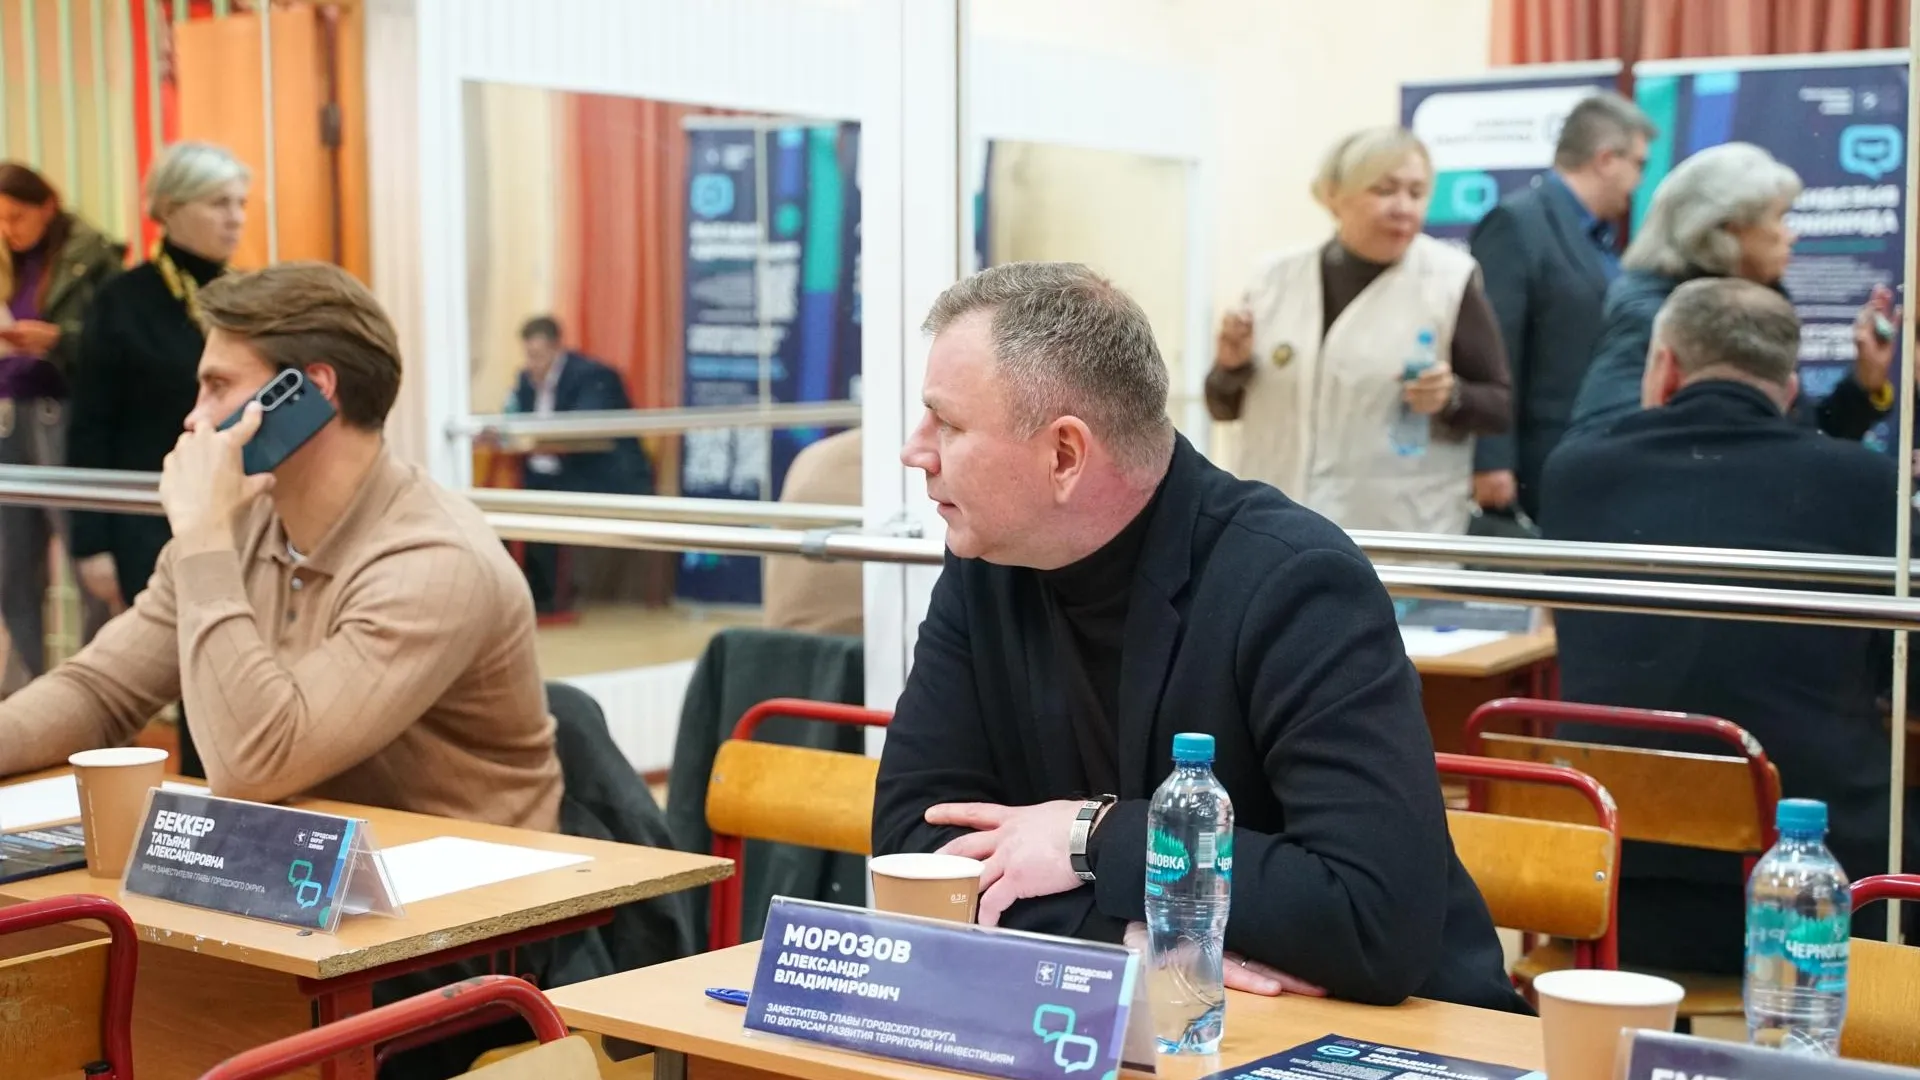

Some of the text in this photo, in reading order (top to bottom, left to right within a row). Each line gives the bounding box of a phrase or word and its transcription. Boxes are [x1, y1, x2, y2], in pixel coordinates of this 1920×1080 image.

[153, 809, 216, 837] БЕККЕР
[151, 831, 191, 850] ТАТЬЯНА
[146, 844, 225, 870] АЛЕКСАНДРОВНА
[156, 865, 193, 878] ЗАМЕСТИТЕЛЯ
[192, 872, 211, 883] ГЛАВЫ
[211, 875, 245, 890] ГОРОДСКОГО
[244, 882, 266, 893] ОКРУГА
[783, 923, 912, 964] МОРОЗОВ
[777, 952, 870, 978] АЛЕКСАНДР
[774, 968, 901, 1002] ВЛАДИМИРОВИЧ
[766, 1002, 957, 1043] ЗАМЕСТИТЕЛЬ ГЛАВЫ ГОРОДСКОГО ОКРУГА
[763, 1013, 1015, 1066] ПО ВОПРОСАМ РАЗВИТИЯ ТЕРРИТОРИЙ И ИНВЕСТИЦИЯМ
